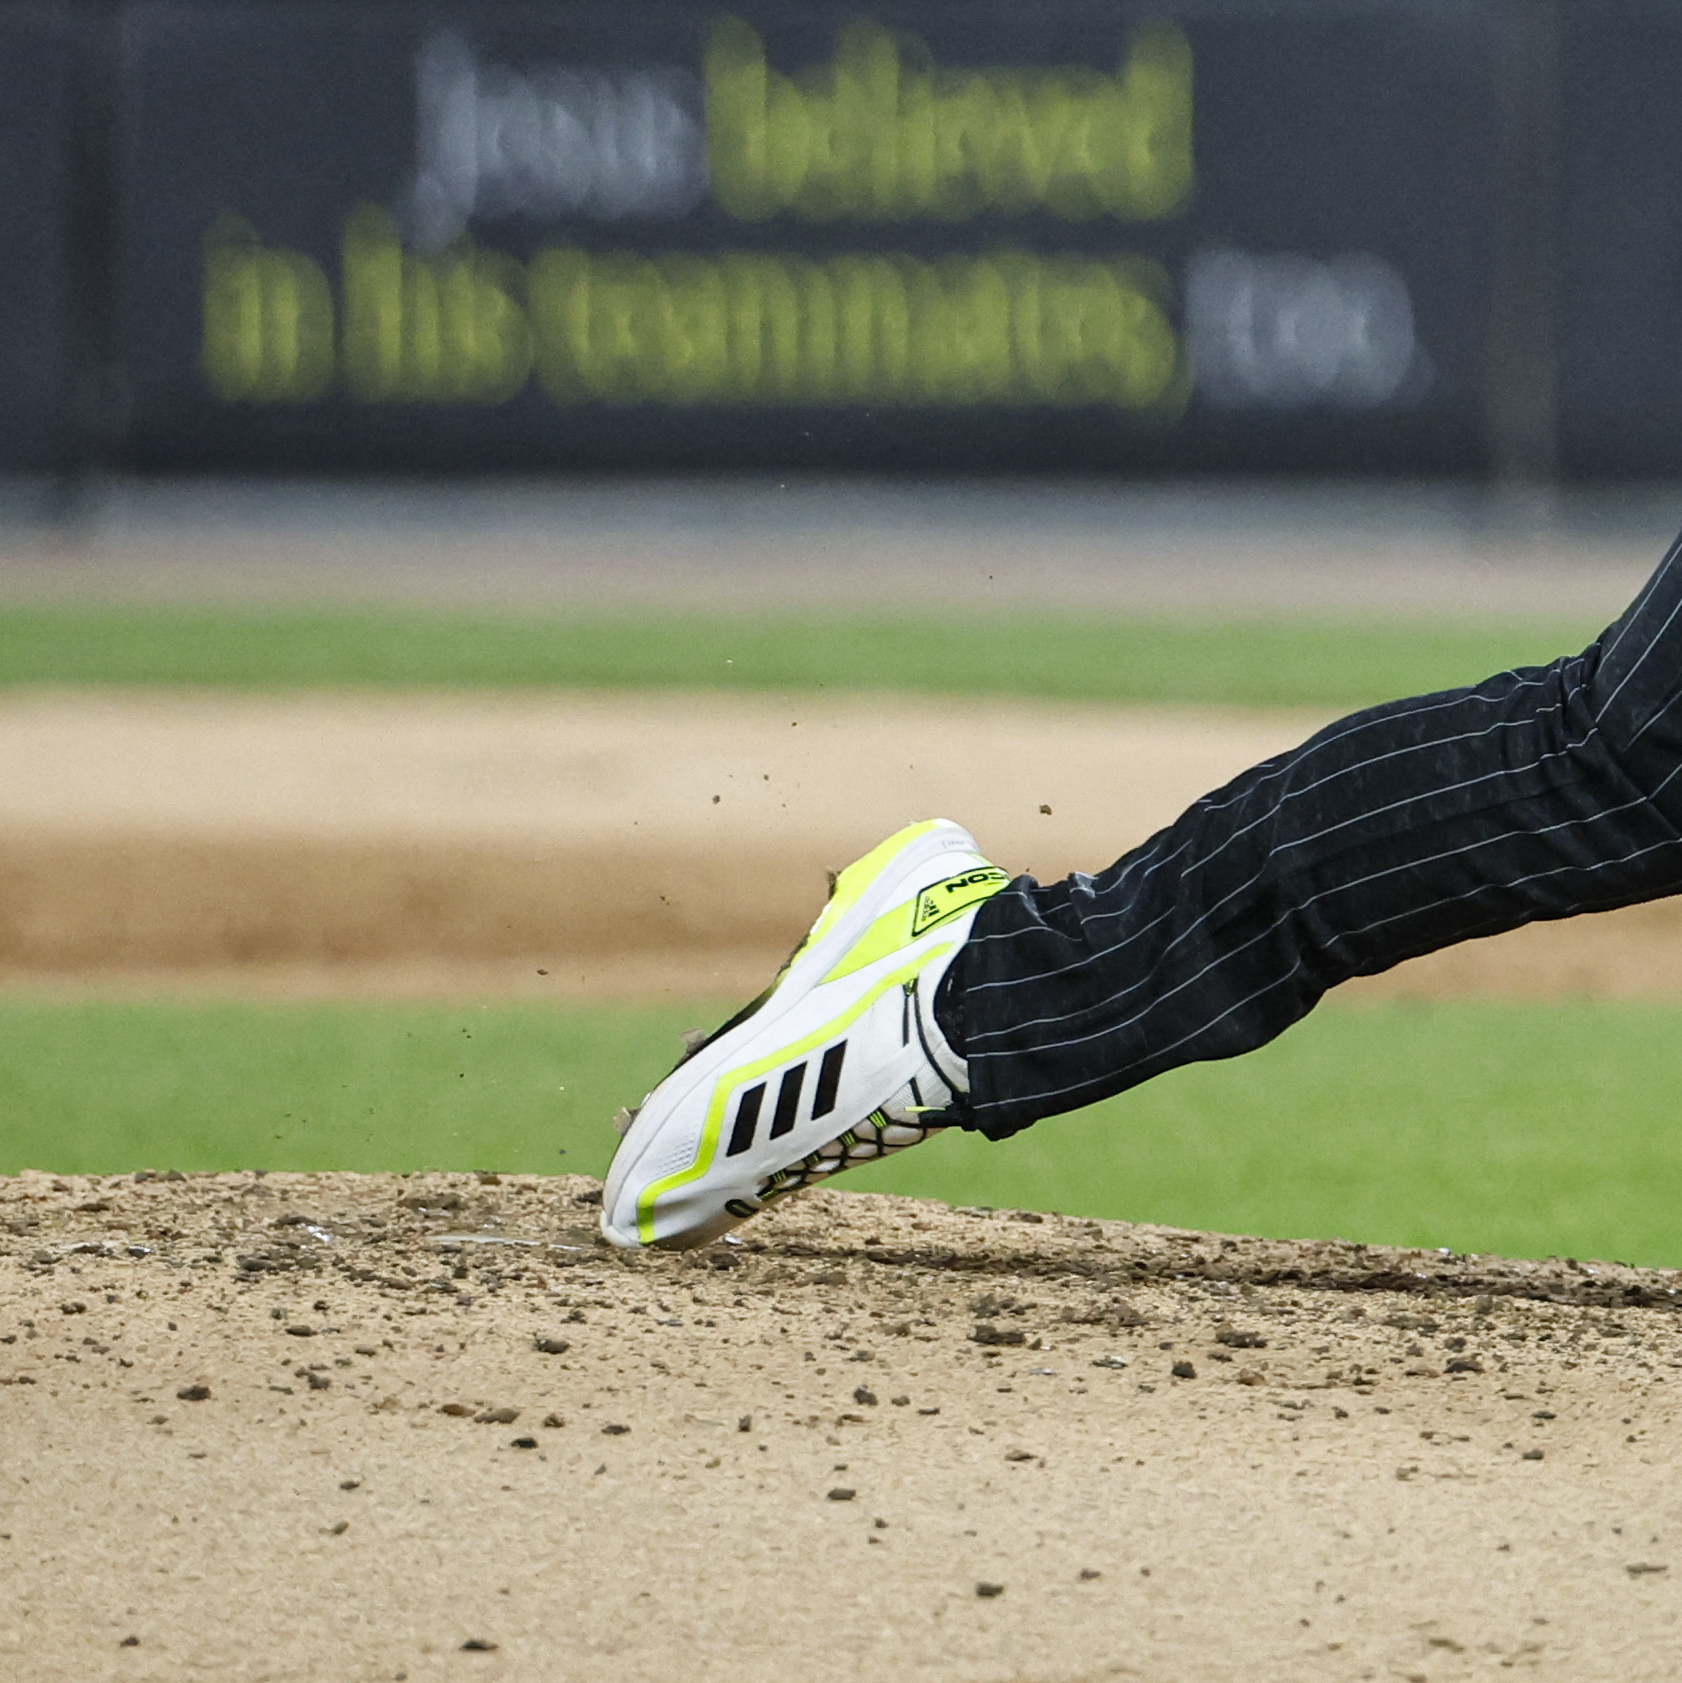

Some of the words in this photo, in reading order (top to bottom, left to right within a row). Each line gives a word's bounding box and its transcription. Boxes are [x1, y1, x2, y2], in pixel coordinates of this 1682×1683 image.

[703, 16, 1194, 221] believed
[205, 211, 335, 404] in
[342, 201, 530, 404] his
